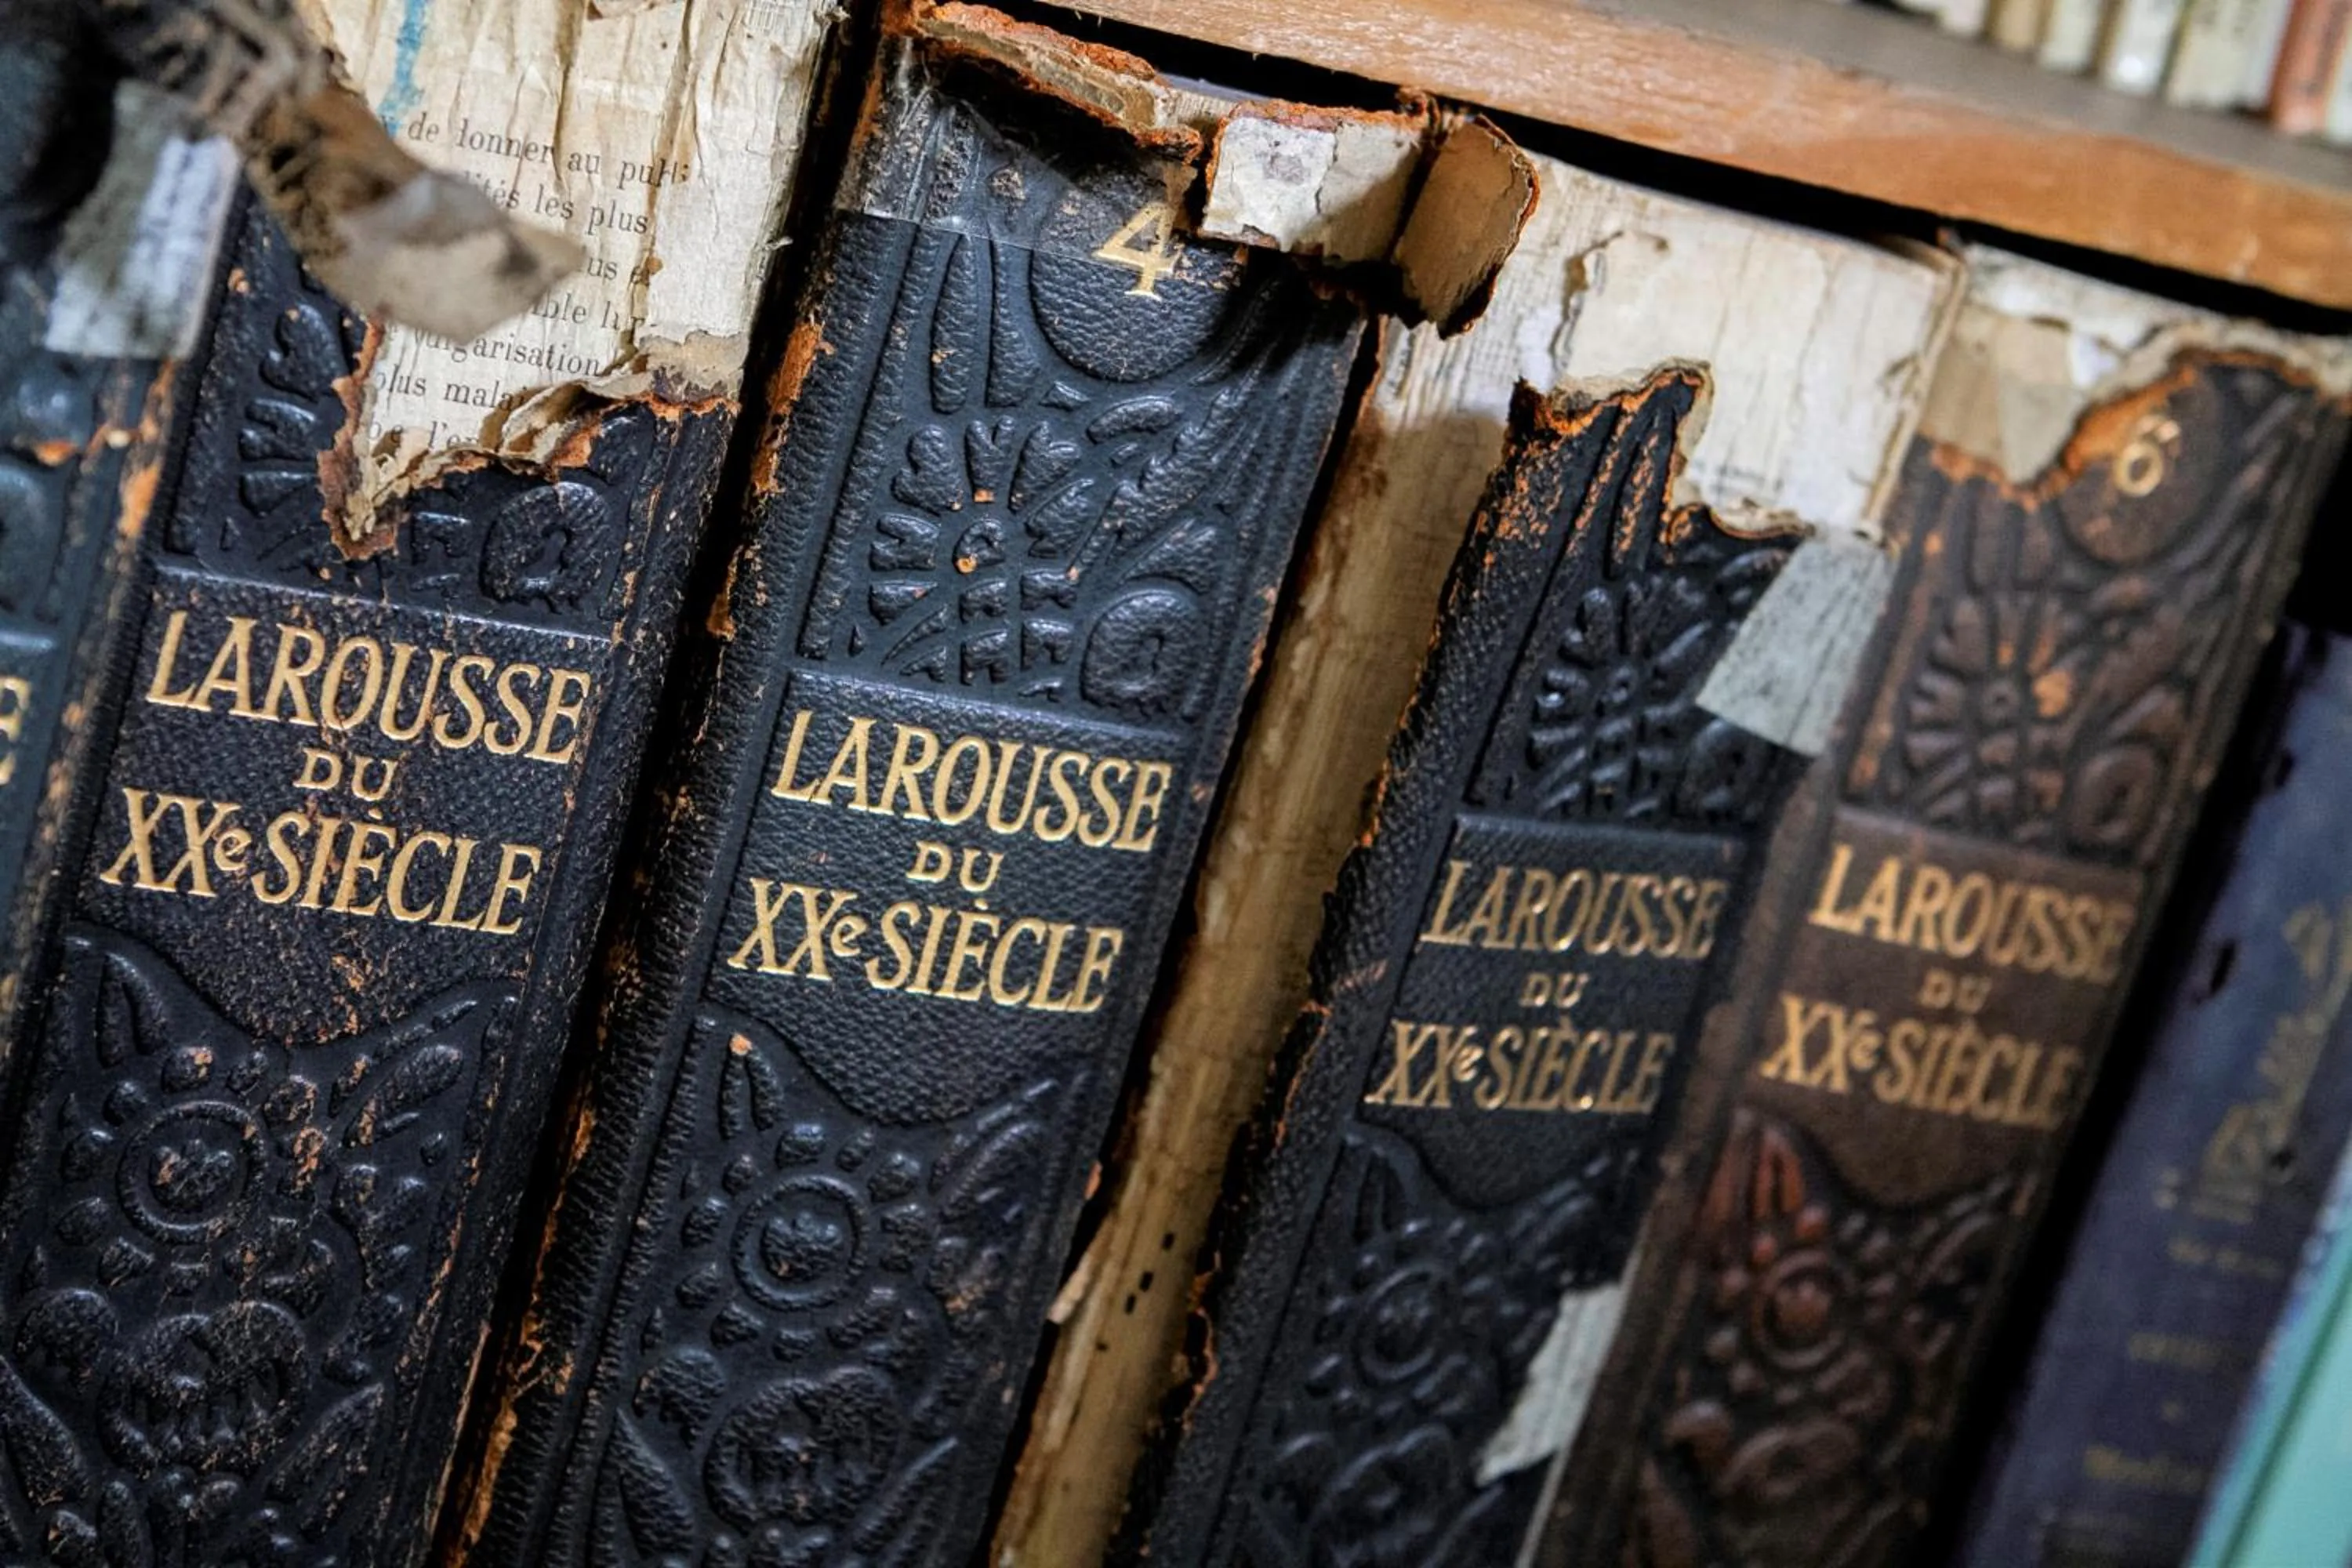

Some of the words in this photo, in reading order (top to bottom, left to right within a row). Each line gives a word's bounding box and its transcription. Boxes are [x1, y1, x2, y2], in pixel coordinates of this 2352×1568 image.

[407, 111, 440, 143] de
[567, 151, 601, 175] au
[534, 183, 575, 220] les
[586, 199, 648, 236] plus
[1091, 201, 1185, 302] 4
[2113, 415, 2181, 497] 6
[146, 611, 592, 764] LAROUSSE
[293, 747, 398, 802] DU
[771, 710, 1172, 852] LAROUSSE
[100, 787, 252, 898] XXe
[252, 808, 542, 935] SIÈCLE
[906, 840, 1004, 892] DU
[727, 877, 869, 982] XXe
[865, 898, 1123, 1013] SIÈCLE
[1420, 860, 1729, 960] LAROUSSE
[1809, 843, 2134, 984] LAROUSSE
[1519, 972, 1589, 1008] DU
[1918, 967, 1992, 1014] DU
[1364, 1019, 1484, 1108] XXe
[1760, 991, 1882, 1094] XXe
